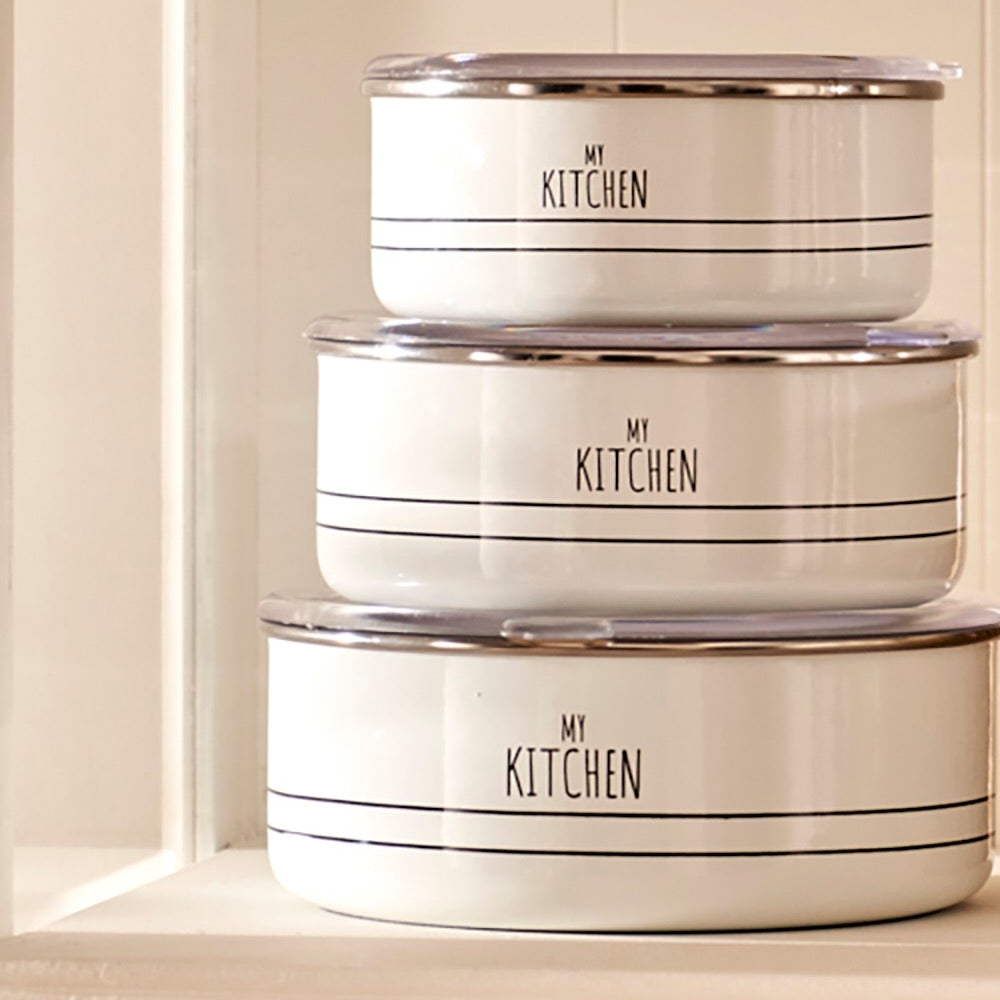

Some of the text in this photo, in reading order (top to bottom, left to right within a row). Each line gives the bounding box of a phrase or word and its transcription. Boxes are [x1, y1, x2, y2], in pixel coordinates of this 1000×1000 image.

[584, 144, 604, 166] MY
[542, 169, 648, 209] KITCHEN
[626, 417, 649, 443] MY
[576, 446, 698, 493] KITCHEN
[561, 714, 586, 743] MY
[506, 746, 642, 799] KITCHEN
